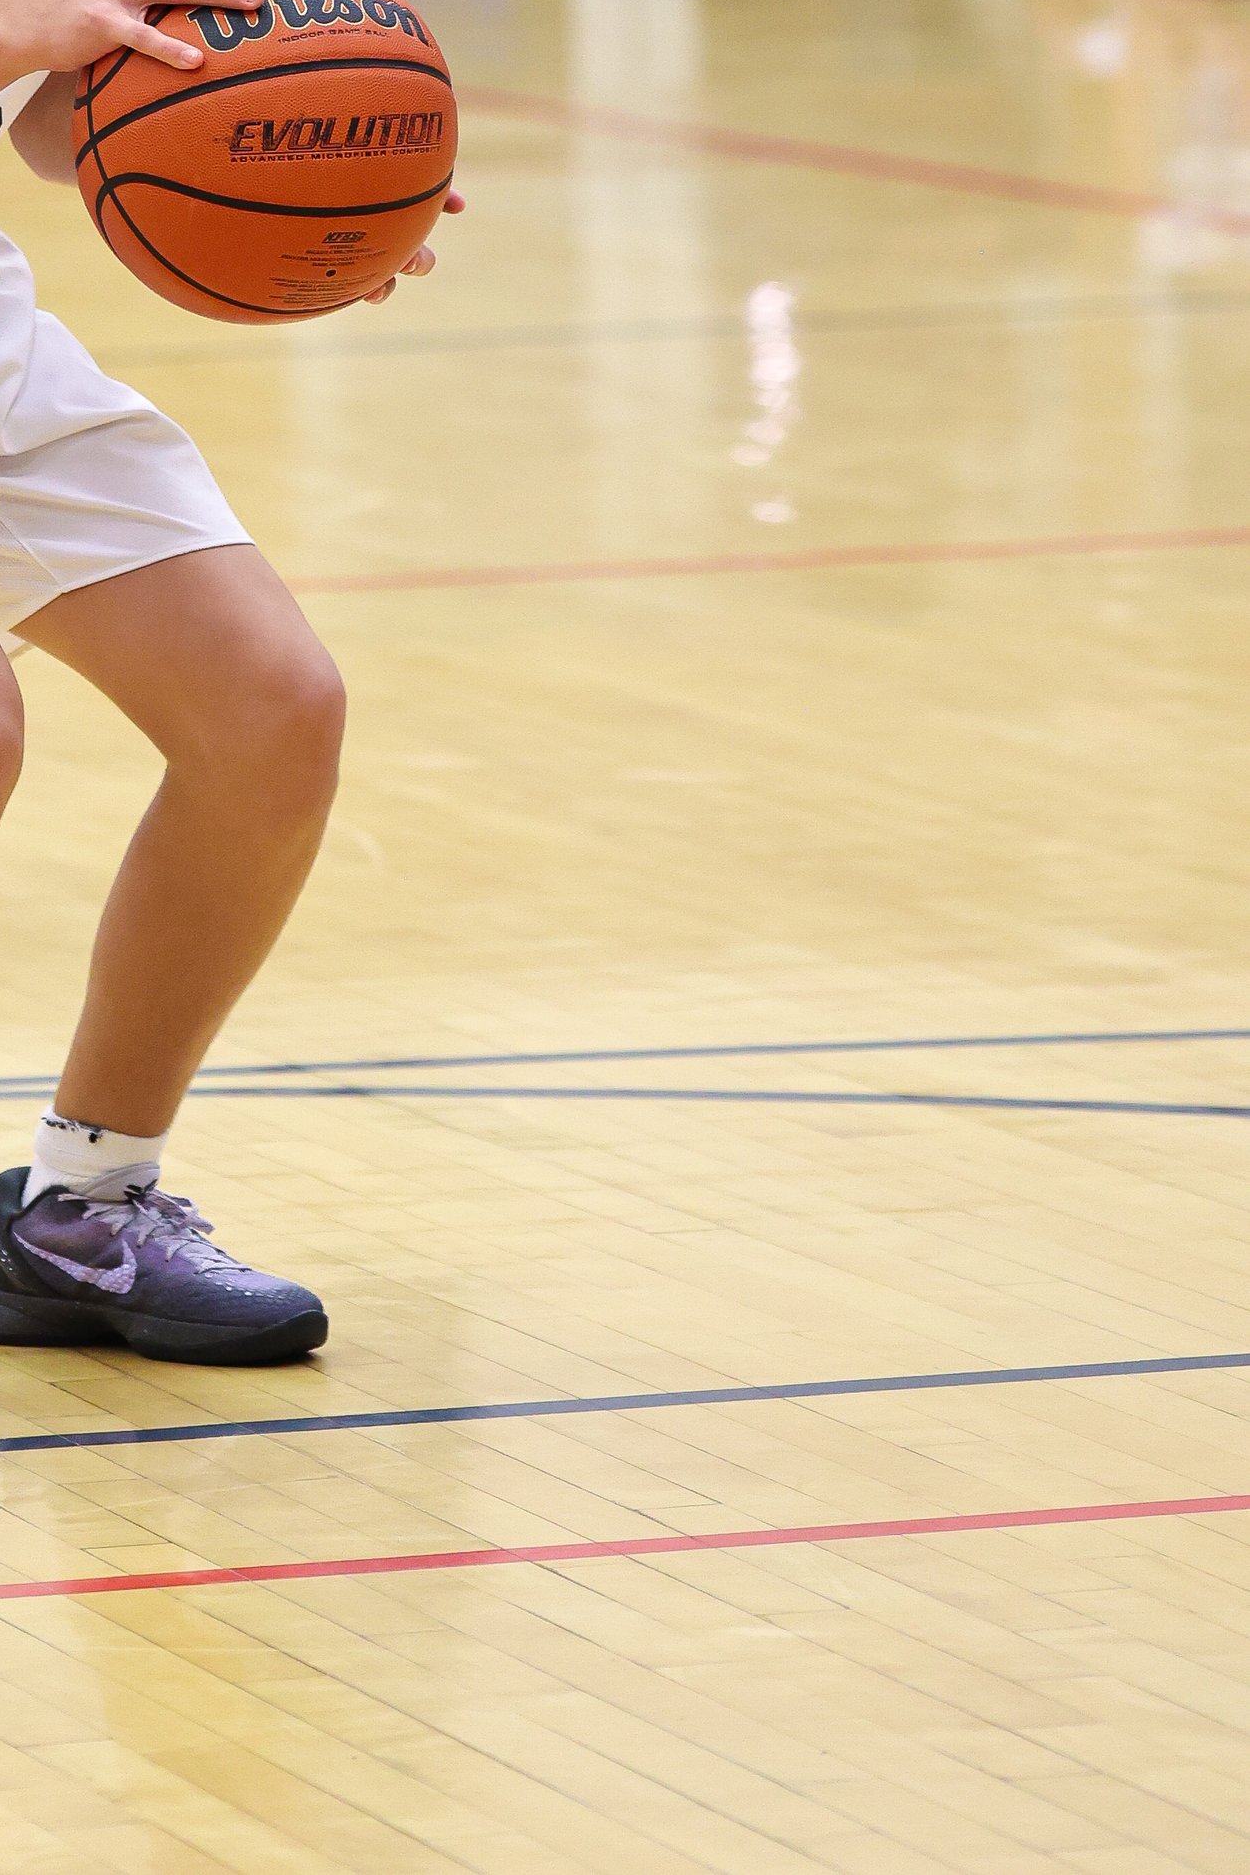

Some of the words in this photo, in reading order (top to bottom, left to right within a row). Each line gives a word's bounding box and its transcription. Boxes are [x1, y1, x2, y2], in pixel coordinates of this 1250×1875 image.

[278, 31, 325, 44] INDOOR
[329, 28, 361, 36] GAME
[229, 111, 443, 152] EVOLUTION
[230, 153, 304, 163] ADVANCED
[311, 150, 387, 160] MICROFIBER
